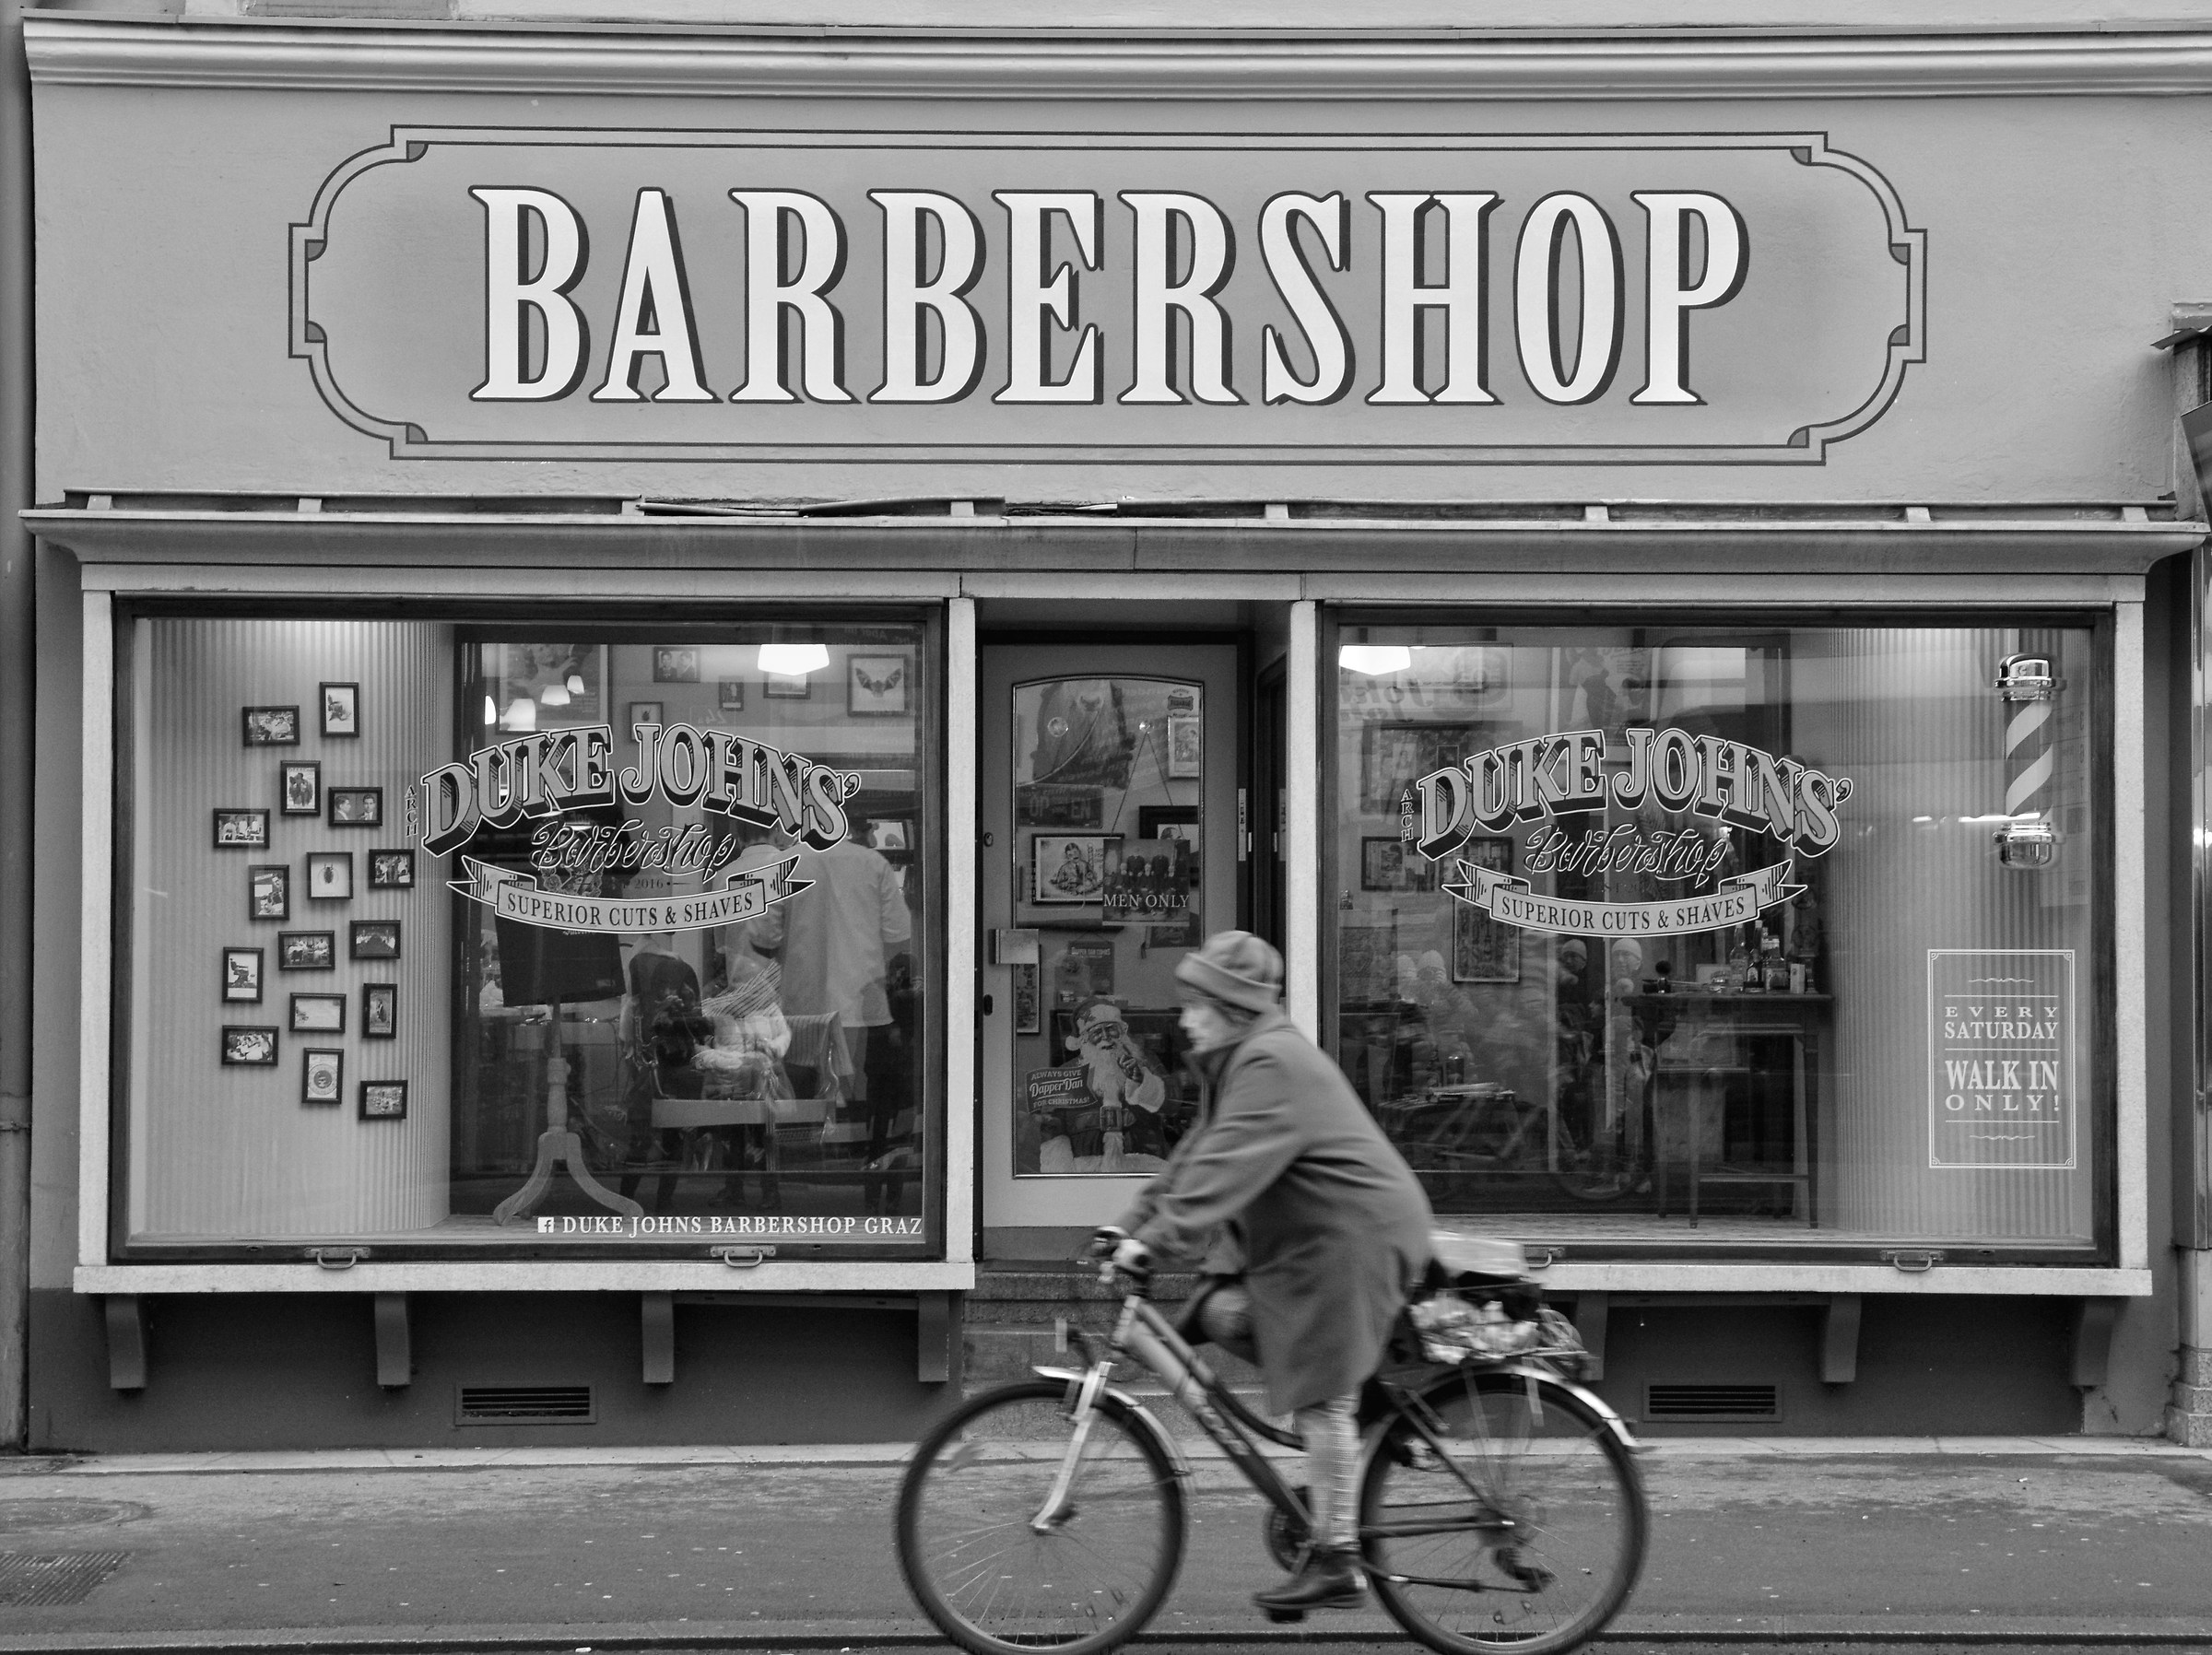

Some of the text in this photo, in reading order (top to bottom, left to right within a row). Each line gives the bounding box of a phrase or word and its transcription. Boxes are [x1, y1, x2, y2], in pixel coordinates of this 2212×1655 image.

[468, 186, 1749, 405] BARBERSHOP
[421, 723, 615, 857] DUKE
[1417, 728, 1608, 861] DUKE
[404, 784, 418, 837] ARCH
[1400, 788, 1414, 842] ARCH
[530, 818, 736, 884] Barbershop
[1524, 824, 1729, 888] Barbershop
[634, 878, 664, 889] 2016
[507, 892, 754, 926] SUPERIOR CUTS & SHAVES
[1103, 894, 1190, 908] MEN ONLY
[1501, 896, 1746, 930] SUPERIOR CUTS & SHAVES
[1945, 1006, 2058, 1017] EVERY
[1945, 1021, 2059, 1039] SATURDAY
[1029, 1078, 1083, 1097] Dapper Dan
[1030, 1069, 1082, 1081] ALWAYS GIVE
[1945, 1060, 2059, 1091] WALK IN
[1032, 1097, 1090, 1109] FOR CHRISTMAS!
[1945, 1094, 2060, 1111] ONLY!
[562, 1216, 623, 1233] DUKE
[629, 1216, 702, 1238] JOHNS
[710, 1216, 856, 1234] BARBERSHOP
[865, 1217, 922, 1235] GRAZ
